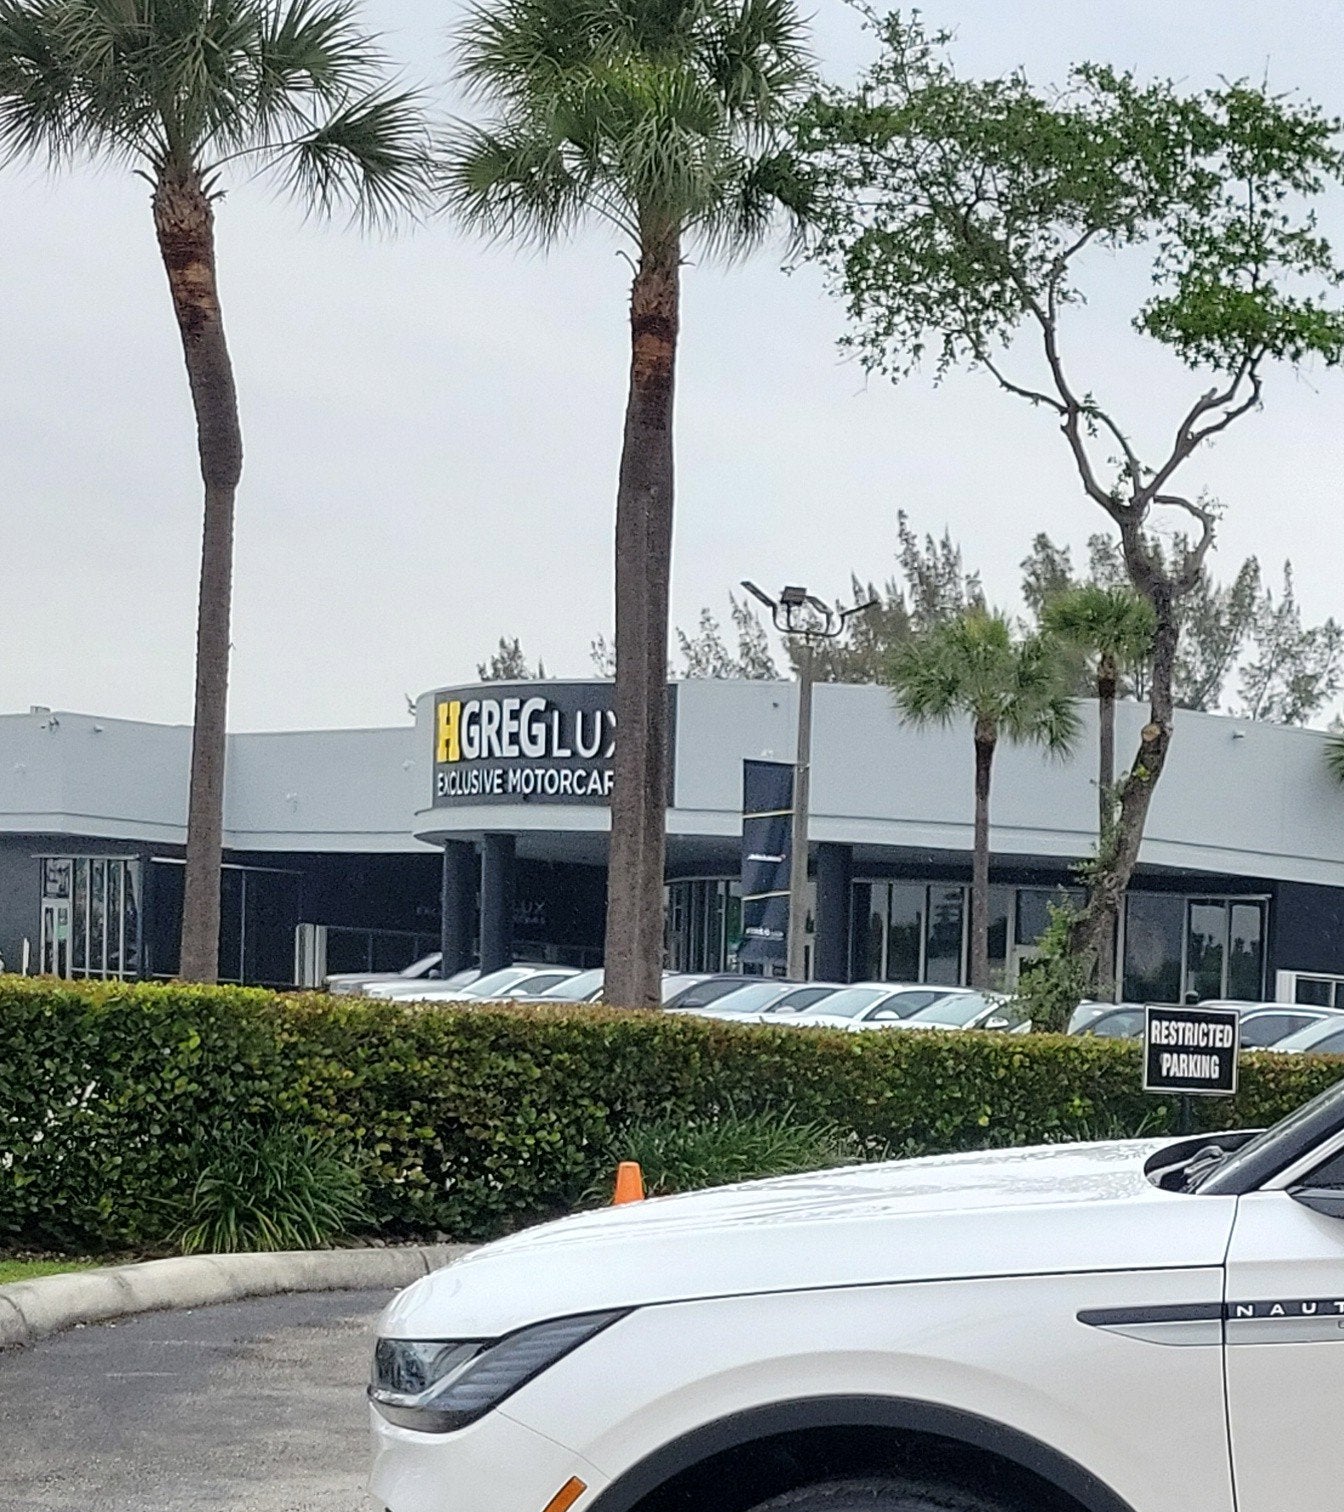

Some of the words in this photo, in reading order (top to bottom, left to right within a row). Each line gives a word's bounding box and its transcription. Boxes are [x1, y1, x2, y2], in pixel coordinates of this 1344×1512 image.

[437, 769, 503, 797] EXCLUSIVE
[508, 767, 614, 796] MOTORCAR
[1151, 1019, 1233, 1048] RESTRICTED
[1161, 1052, 1219, 1079] PARKING
